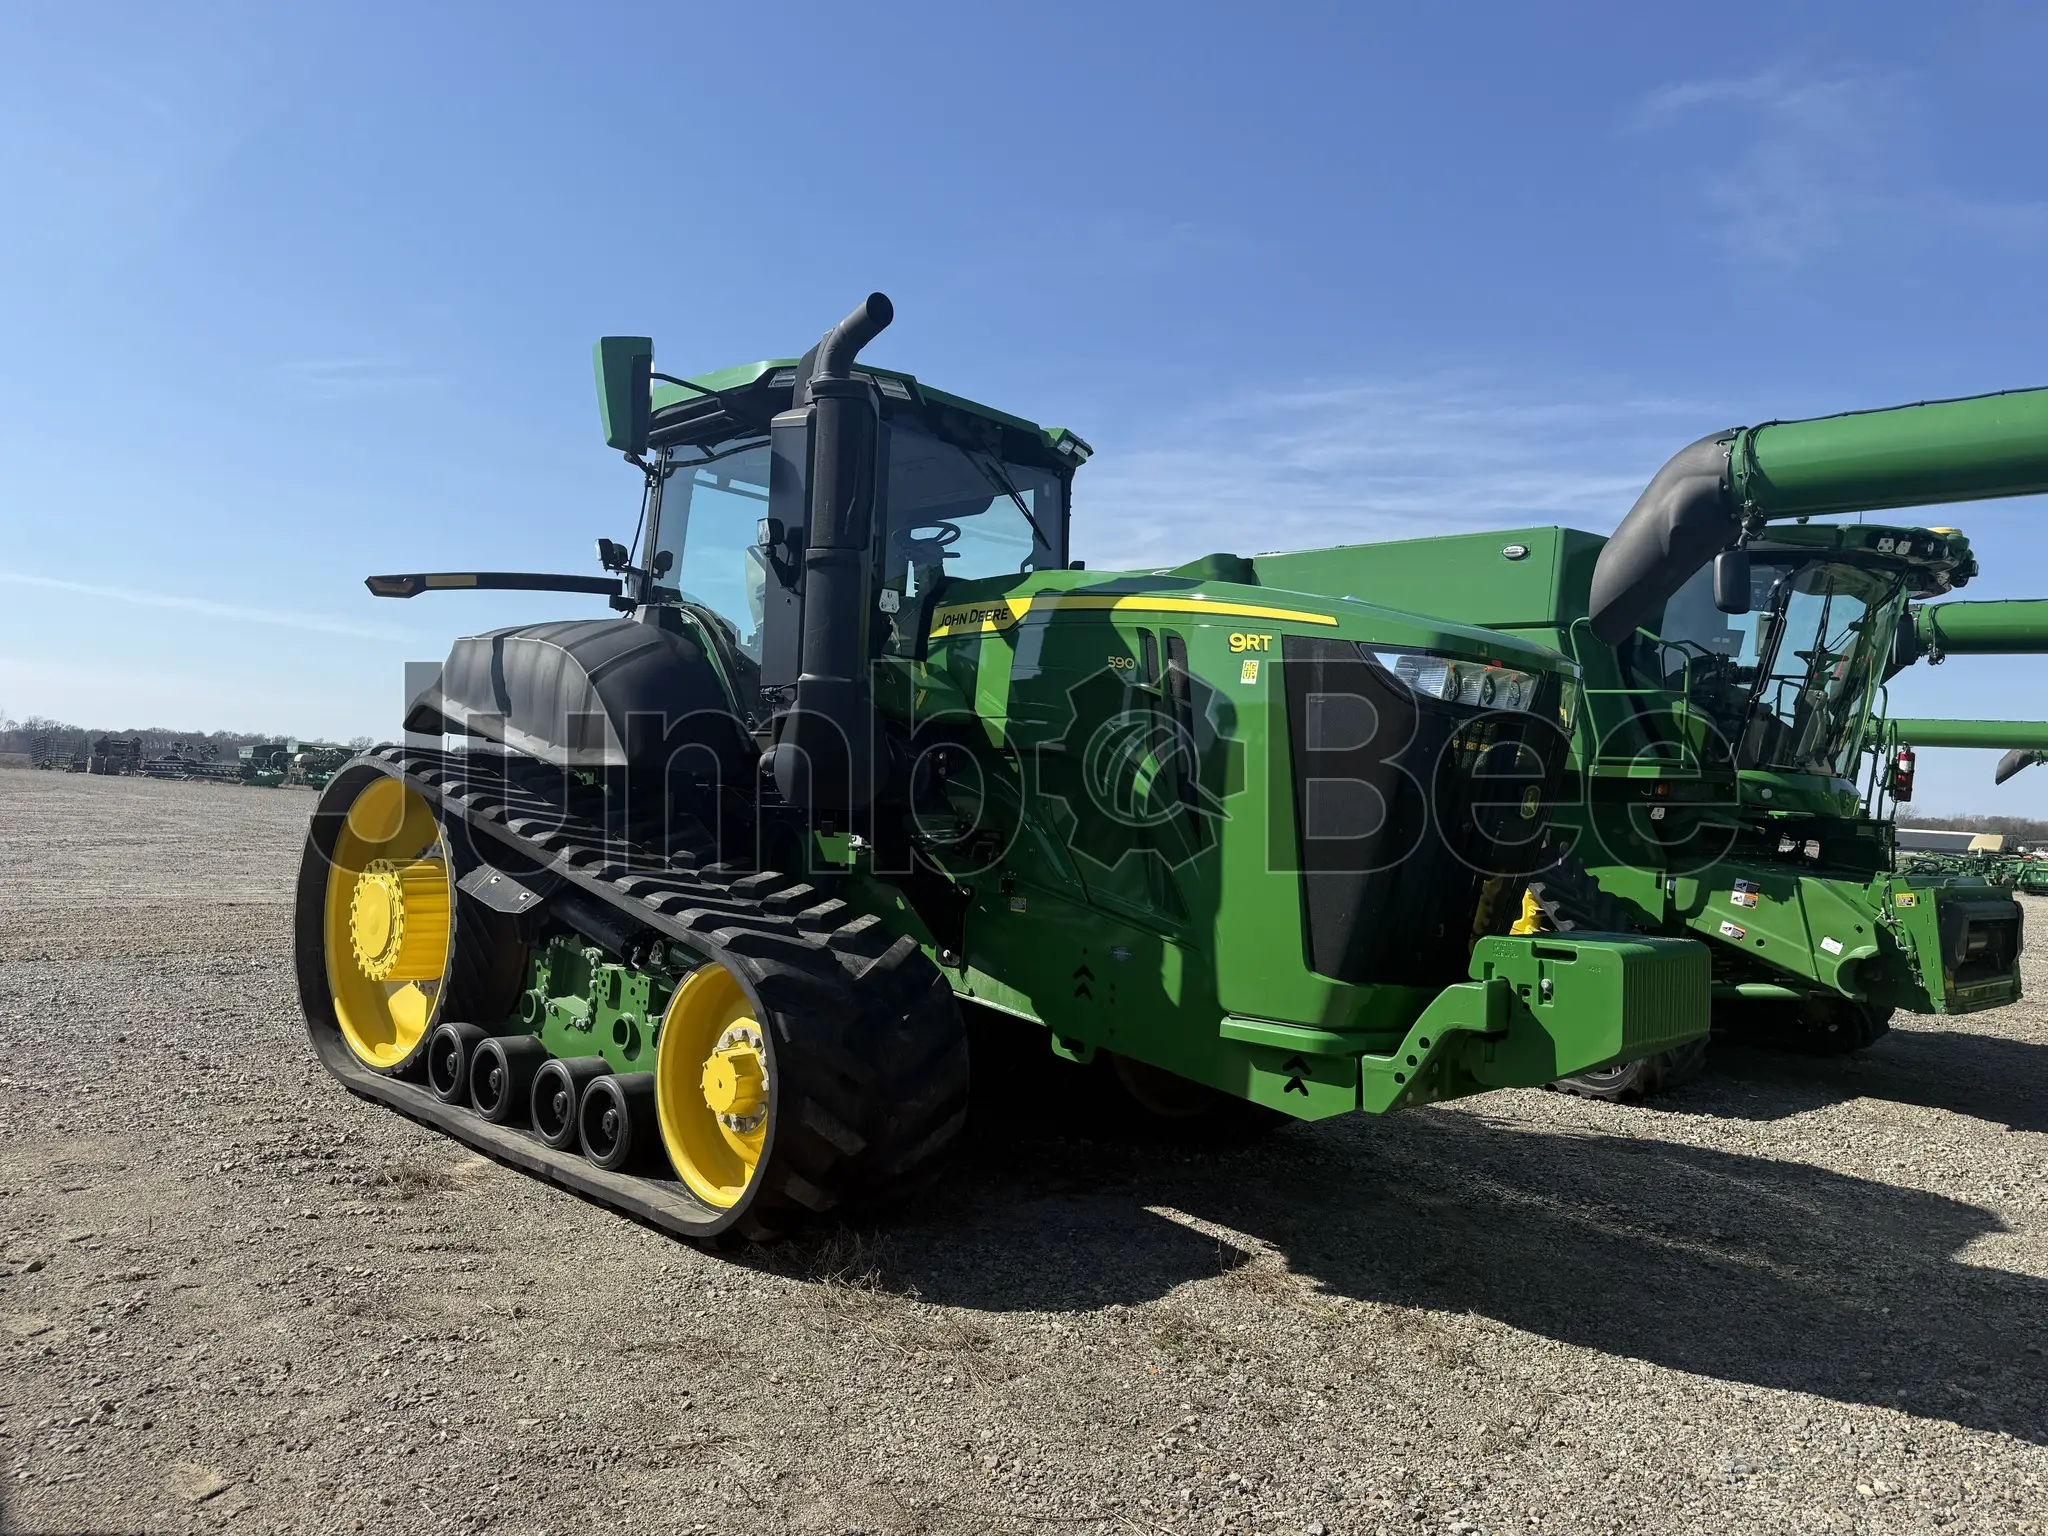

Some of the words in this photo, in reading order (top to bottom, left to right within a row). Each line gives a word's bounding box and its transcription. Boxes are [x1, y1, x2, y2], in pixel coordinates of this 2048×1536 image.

[938, 613, 968, 628] JOHN
[969, 608, 1010, 624] DEERE
[1228, 632, 1273, 653] 9RT
[1107, 655, 1135, 670] 590
[1245, 662, 1257, 670] AG
[1243, 670, 1256, 680] UP
